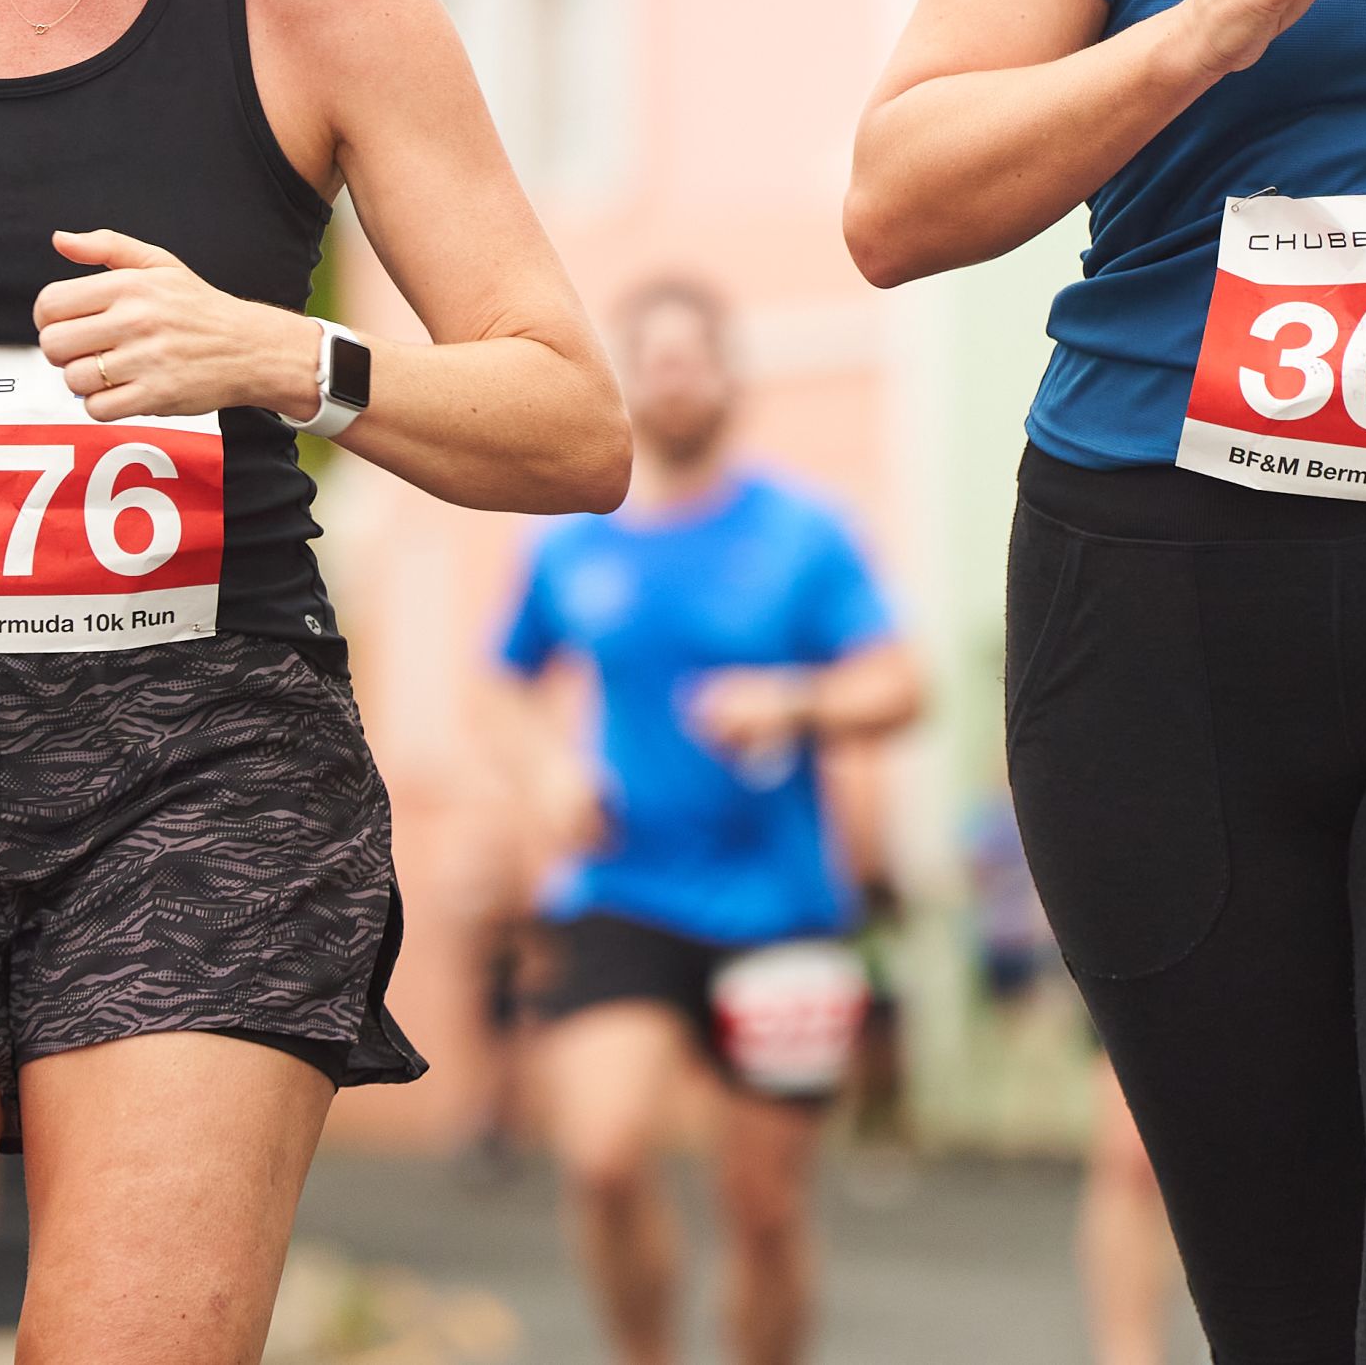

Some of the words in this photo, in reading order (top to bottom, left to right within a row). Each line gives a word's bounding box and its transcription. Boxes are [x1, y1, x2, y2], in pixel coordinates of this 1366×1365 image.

[1228, 446, 1300, 476] BF&M
[83, 612, 124, 632] 10k
[131, 609, 176, 630] Run
